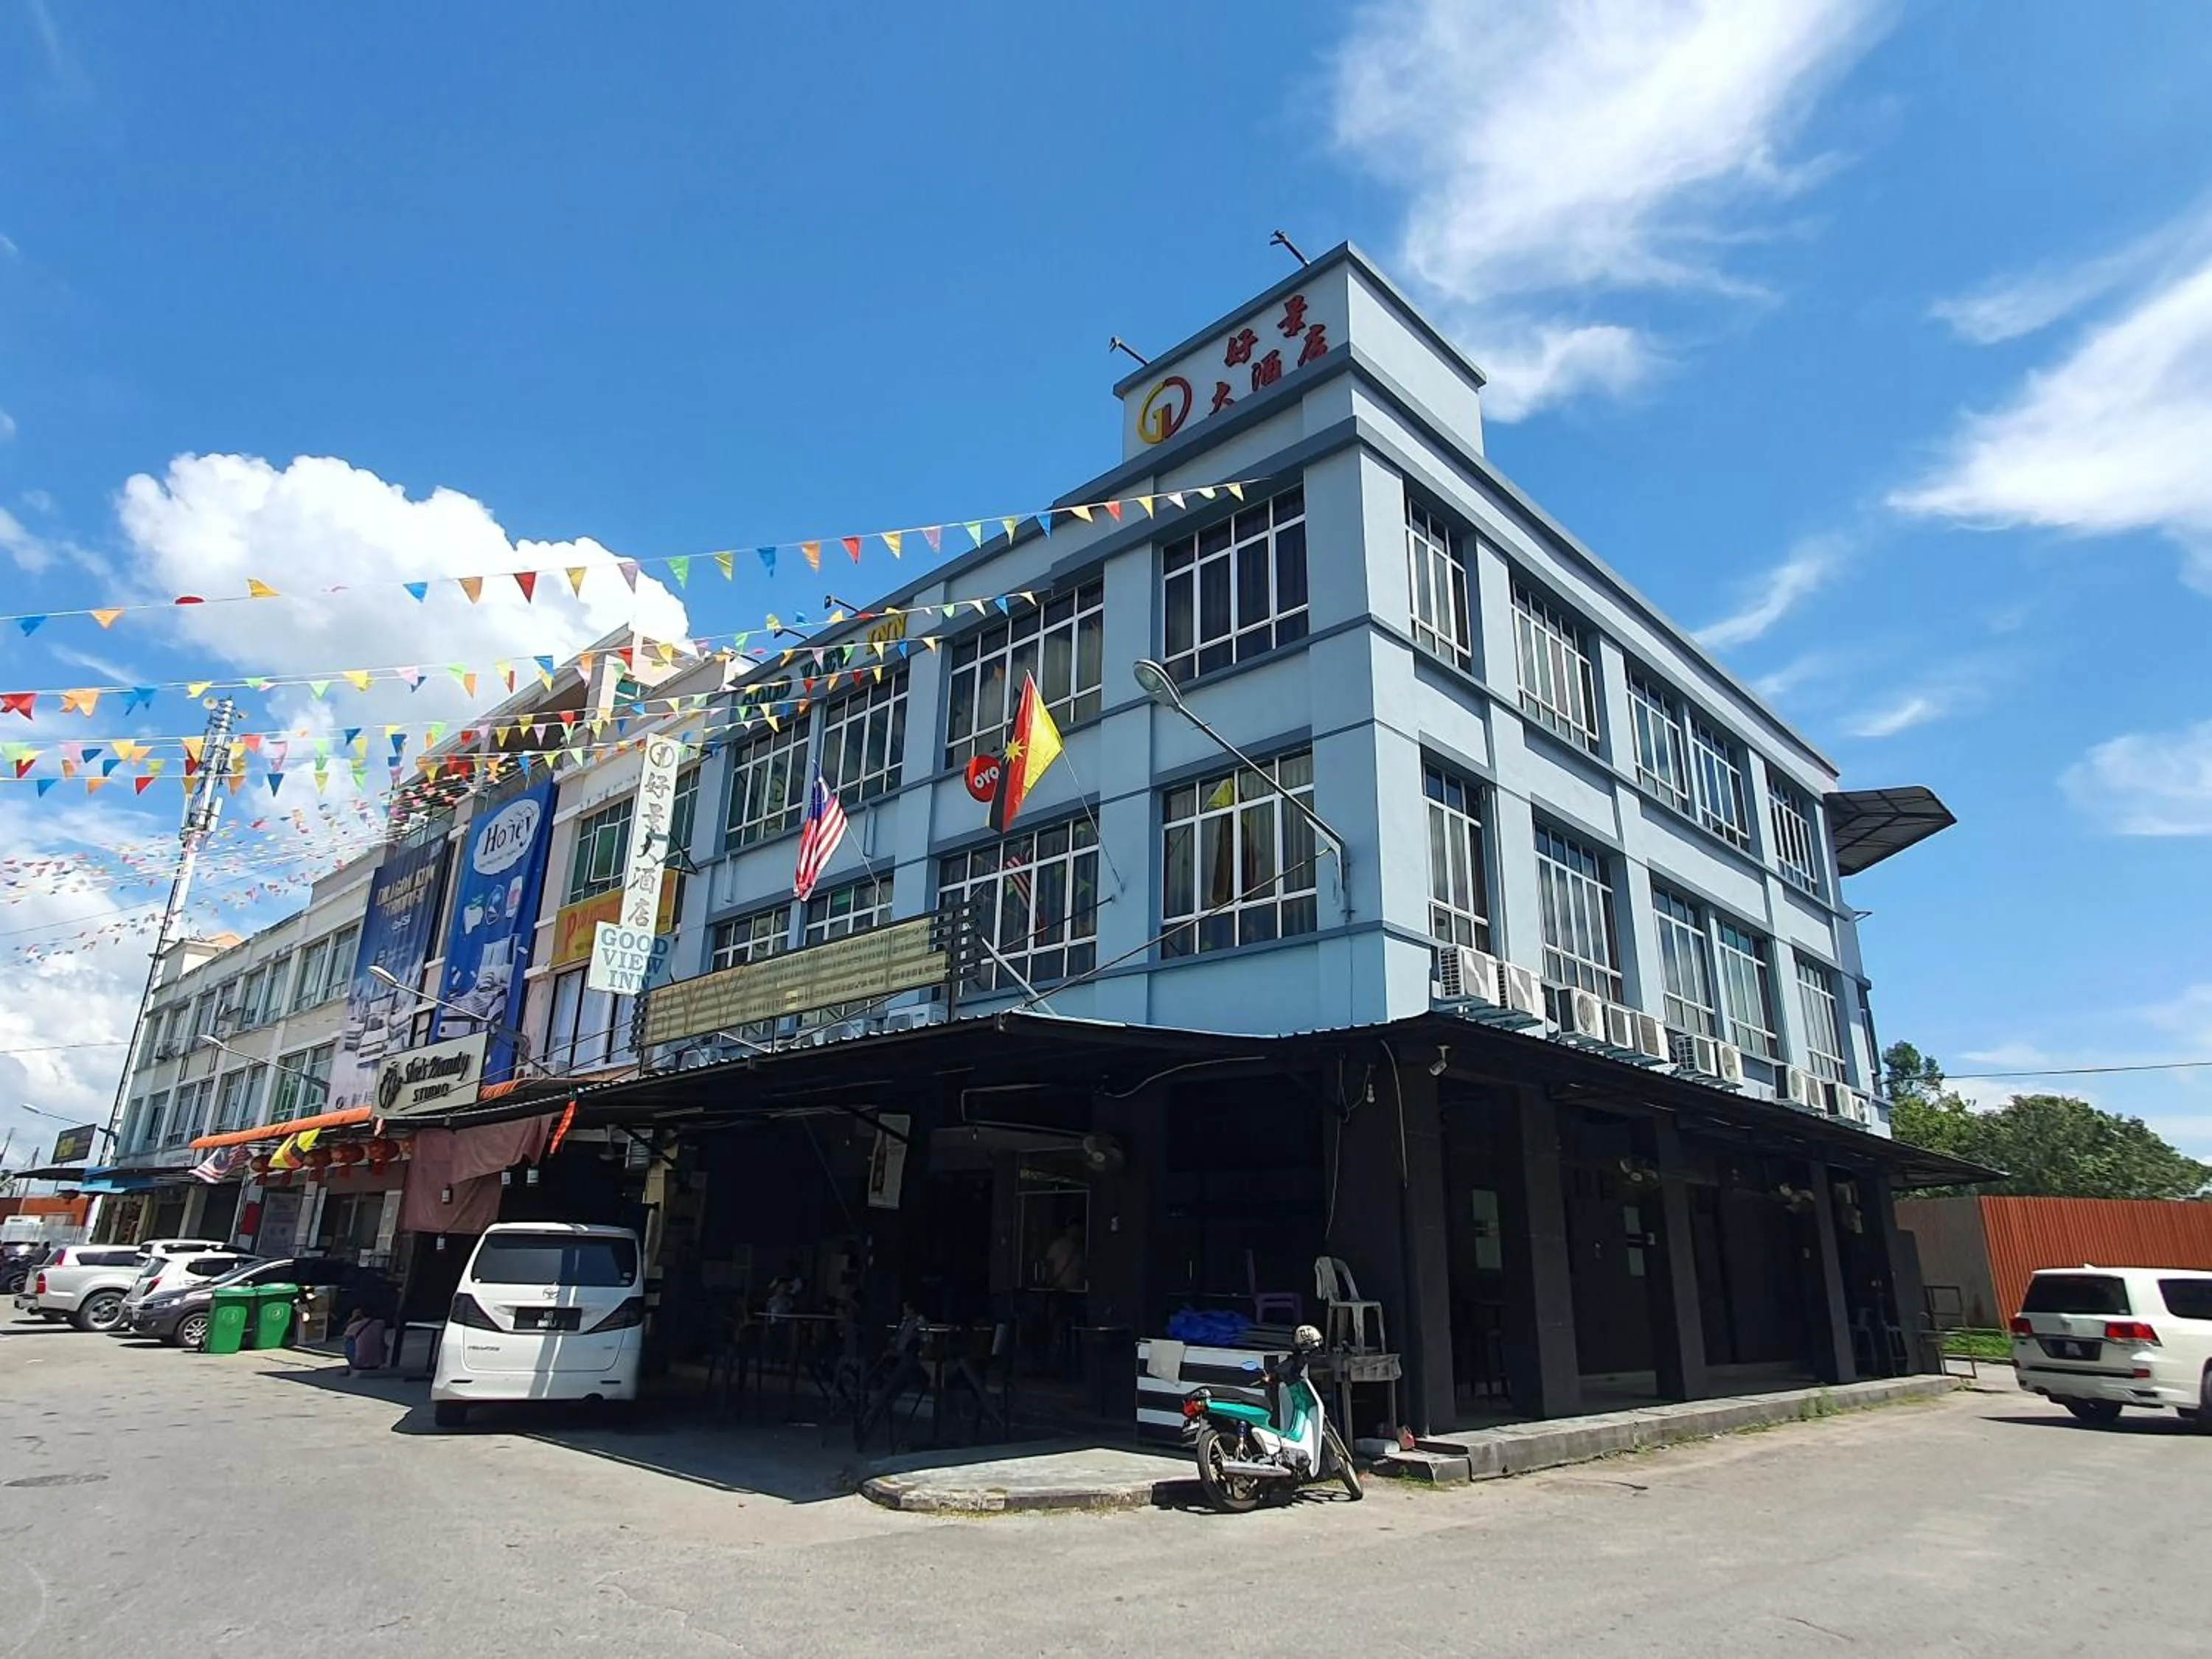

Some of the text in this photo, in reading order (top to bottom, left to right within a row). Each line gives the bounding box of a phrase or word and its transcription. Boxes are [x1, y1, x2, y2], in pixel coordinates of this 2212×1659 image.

[627, 771, 670, 927] 好景大酒店
[601, 928, 669, 956] GOOD
[601, 947, 665, 975] VIEW
[608, 969, 653, 992] INN
[413, 1083, 450, 1102] STUDIO
